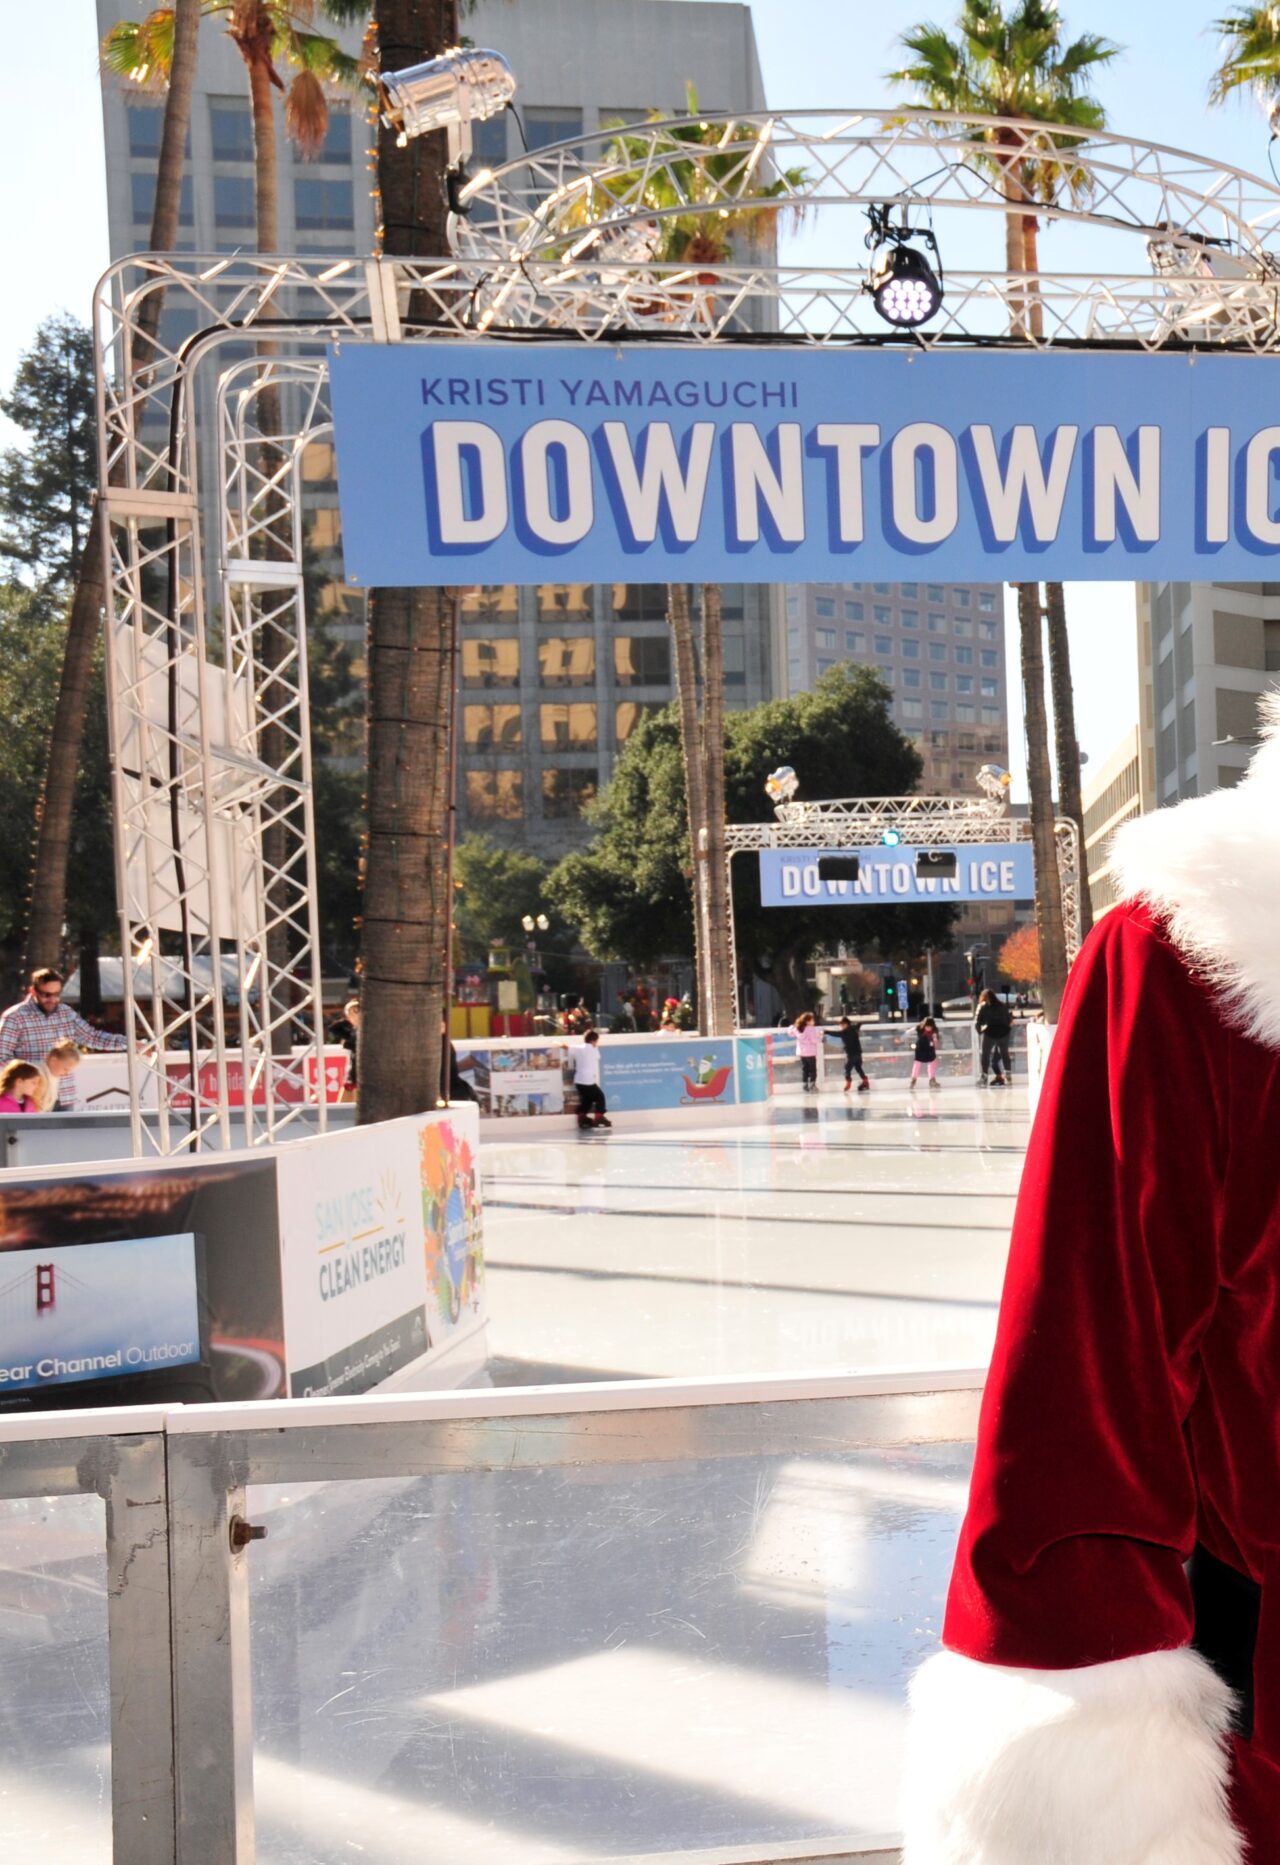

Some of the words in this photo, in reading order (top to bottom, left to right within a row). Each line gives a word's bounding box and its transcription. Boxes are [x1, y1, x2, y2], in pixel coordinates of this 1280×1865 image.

[420, 378, 544, 406] KRISTI
[560, 379, 799, 408] YAMAGUCHI
[420, 418, 1161, 557] DOWNTOWN
[969, 861, 1016, 893] ICE
[320, 1250, 361, 1302] CLEAN
[362, 1231, 406, 1282] ENERGY
[37, 1350, 122, 1377] Channel
[126, 1342, 195, 1365] Outdoor
